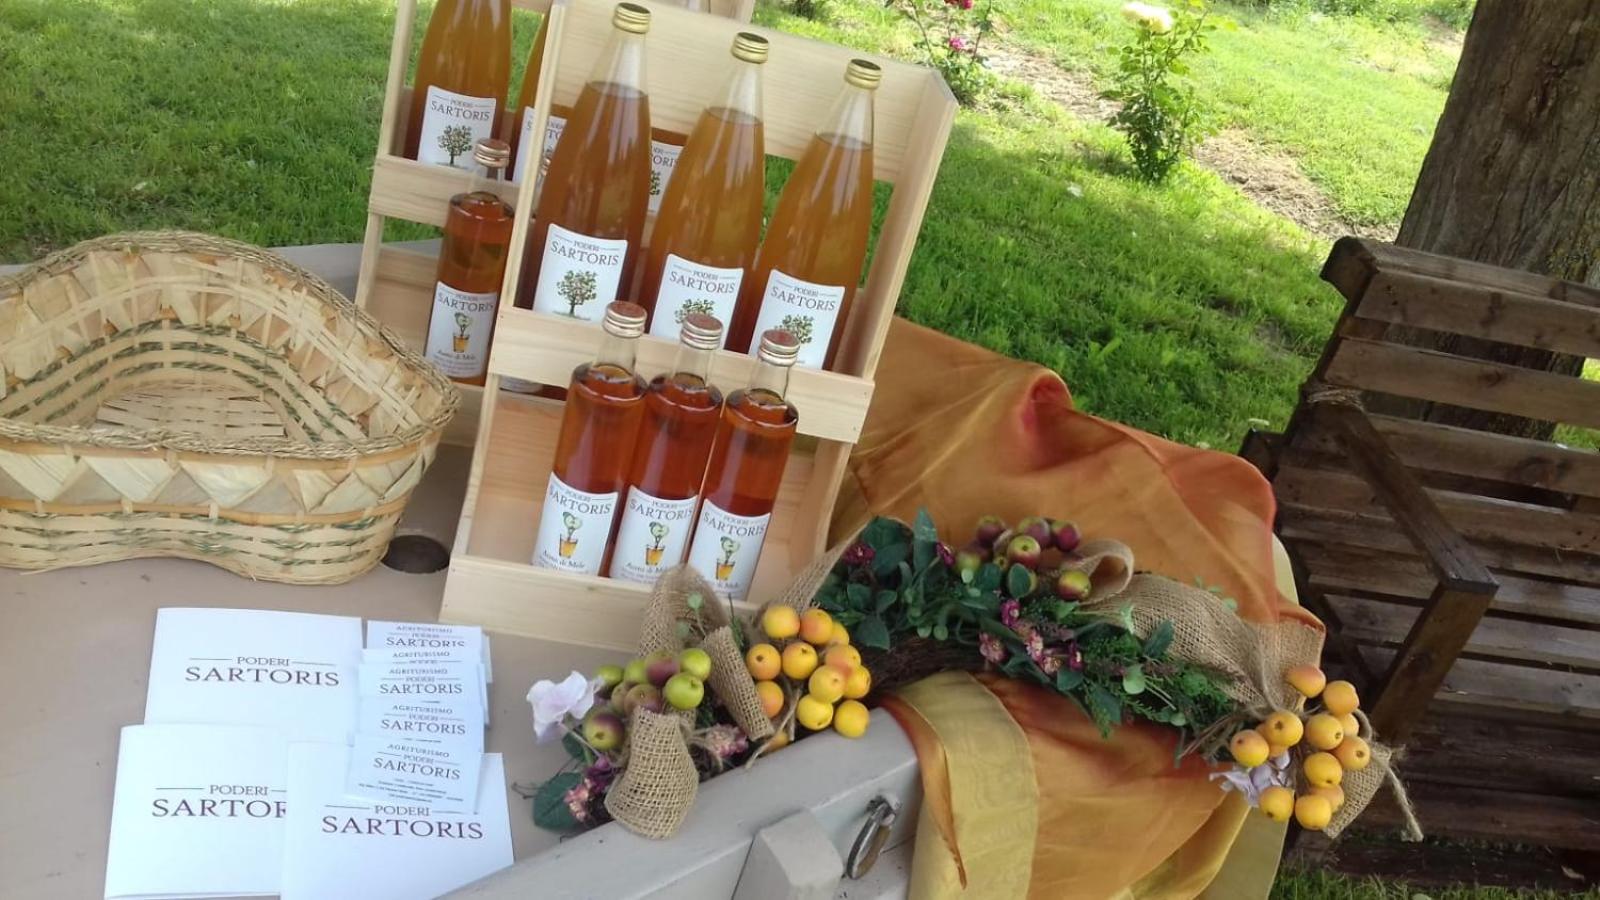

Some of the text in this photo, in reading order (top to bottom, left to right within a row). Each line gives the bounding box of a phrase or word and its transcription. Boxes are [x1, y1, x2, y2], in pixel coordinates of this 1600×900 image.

[431, 100, 490, 121] SARTORIS
[549, 240, 619, 267] SARTORIS
[573, 240, 600, 252] PODERI
[669, 270, 735, 294] SARTORIS
[692, 269, 719, 281] PODERI
[770, 285, 837, 312] SARTORIS
[793, 286, 819, 298] PODERI
[549, 484, 611, 515] SARTORIS
[629, 498, 693, 521] SARTORIS
[703, 511, 764, 537] SARTORIS
[386, 636, 465, 648] SARTORIS
[237, 656, 290, 667] PODERI
[185, 666, 340, 687] SARTORIS
[388, 667, 448, 675] AGRITURISMO
[379, 683, 463, 695] SARTORIS
[391, 704, 453, 715] AGRITURISMO
[381, 719, 466, 735] SARTORIS
[387, 743, 450, 758] AGRITURISMO
[403, 754, 434, 765] PODERI
[373, 757, 461, 780] SARTORIS
[209, 784, 269, 796] PODERI
[152, 798, 287, 818] SARTOR
[374, 805, 431, 817] PODERI
[322, 815, 484, 840] SARTORIS
